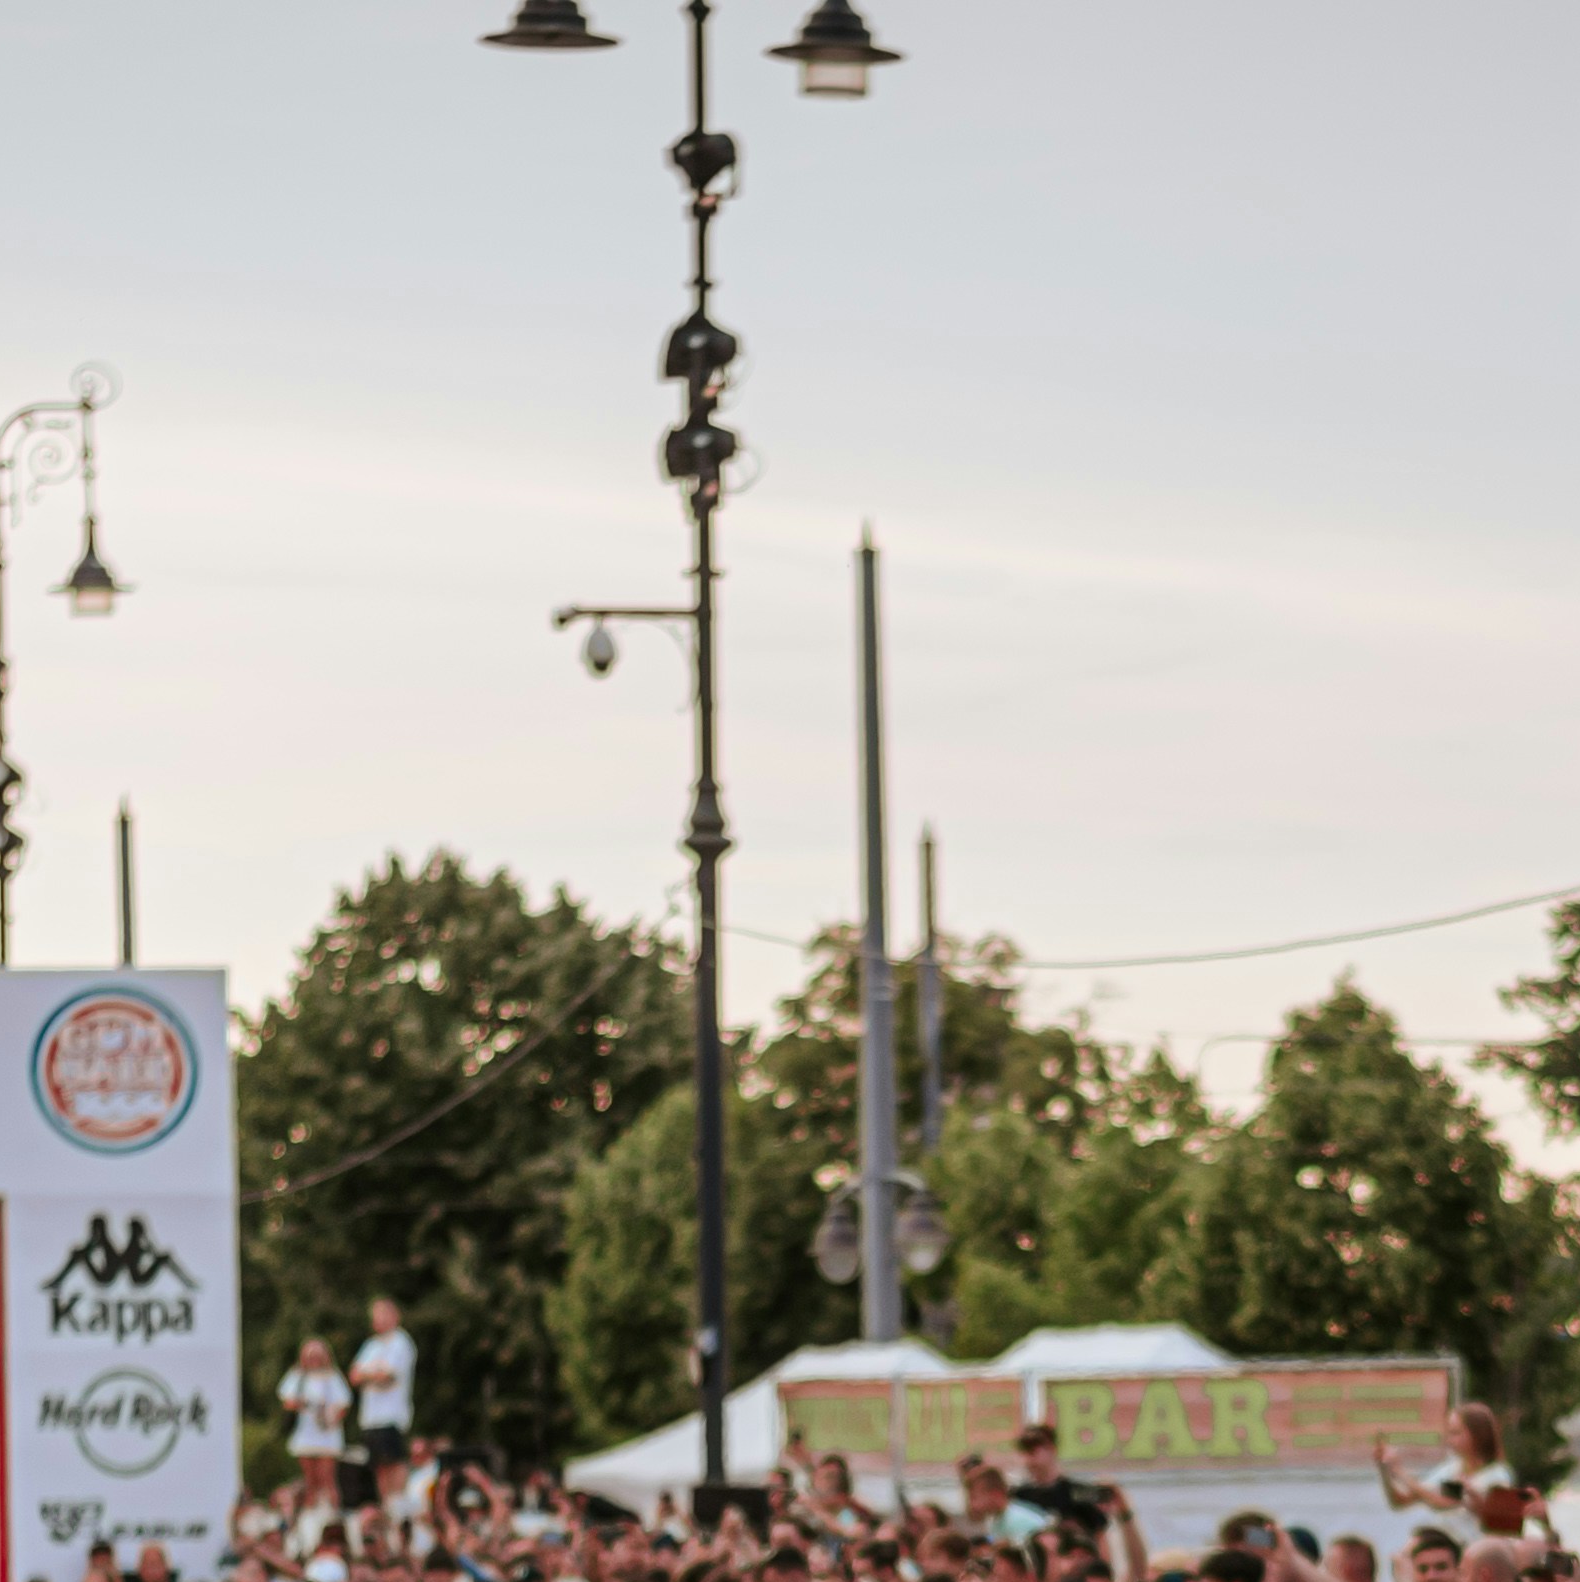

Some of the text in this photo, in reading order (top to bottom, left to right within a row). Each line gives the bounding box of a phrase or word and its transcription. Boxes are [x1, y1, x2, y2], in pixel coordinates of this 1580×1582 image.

[49, 1292, 194, 1344] Kappa
[38, 1391, 209, 1436] Hard Rock
[1053, 1378, 1278, 1461] BAR
